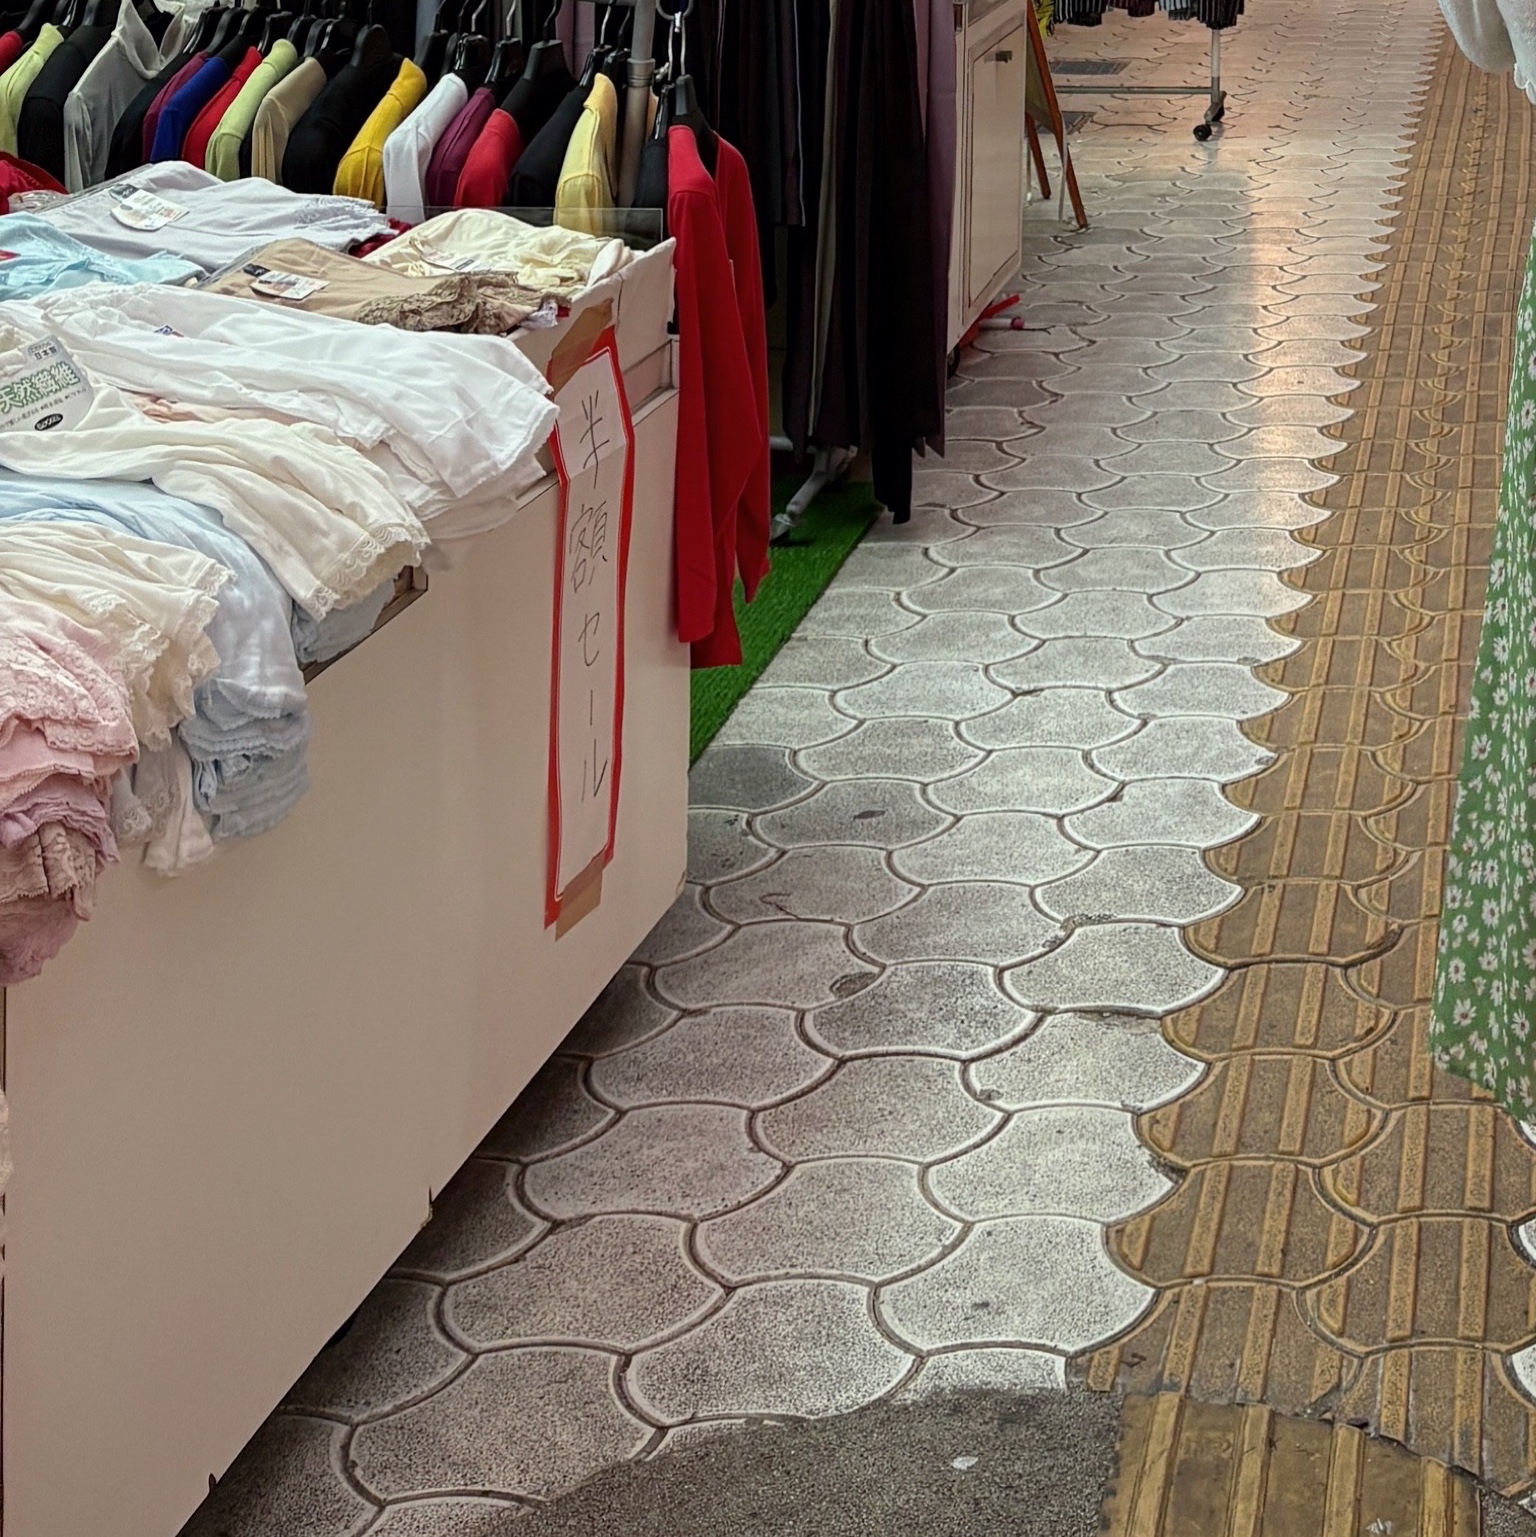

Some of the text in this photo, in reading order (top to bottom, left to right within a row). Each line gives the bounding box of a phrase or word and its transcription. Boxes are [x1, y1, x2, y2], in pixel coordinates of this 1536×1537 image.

[569, 392, 608, 804] 半額セール
